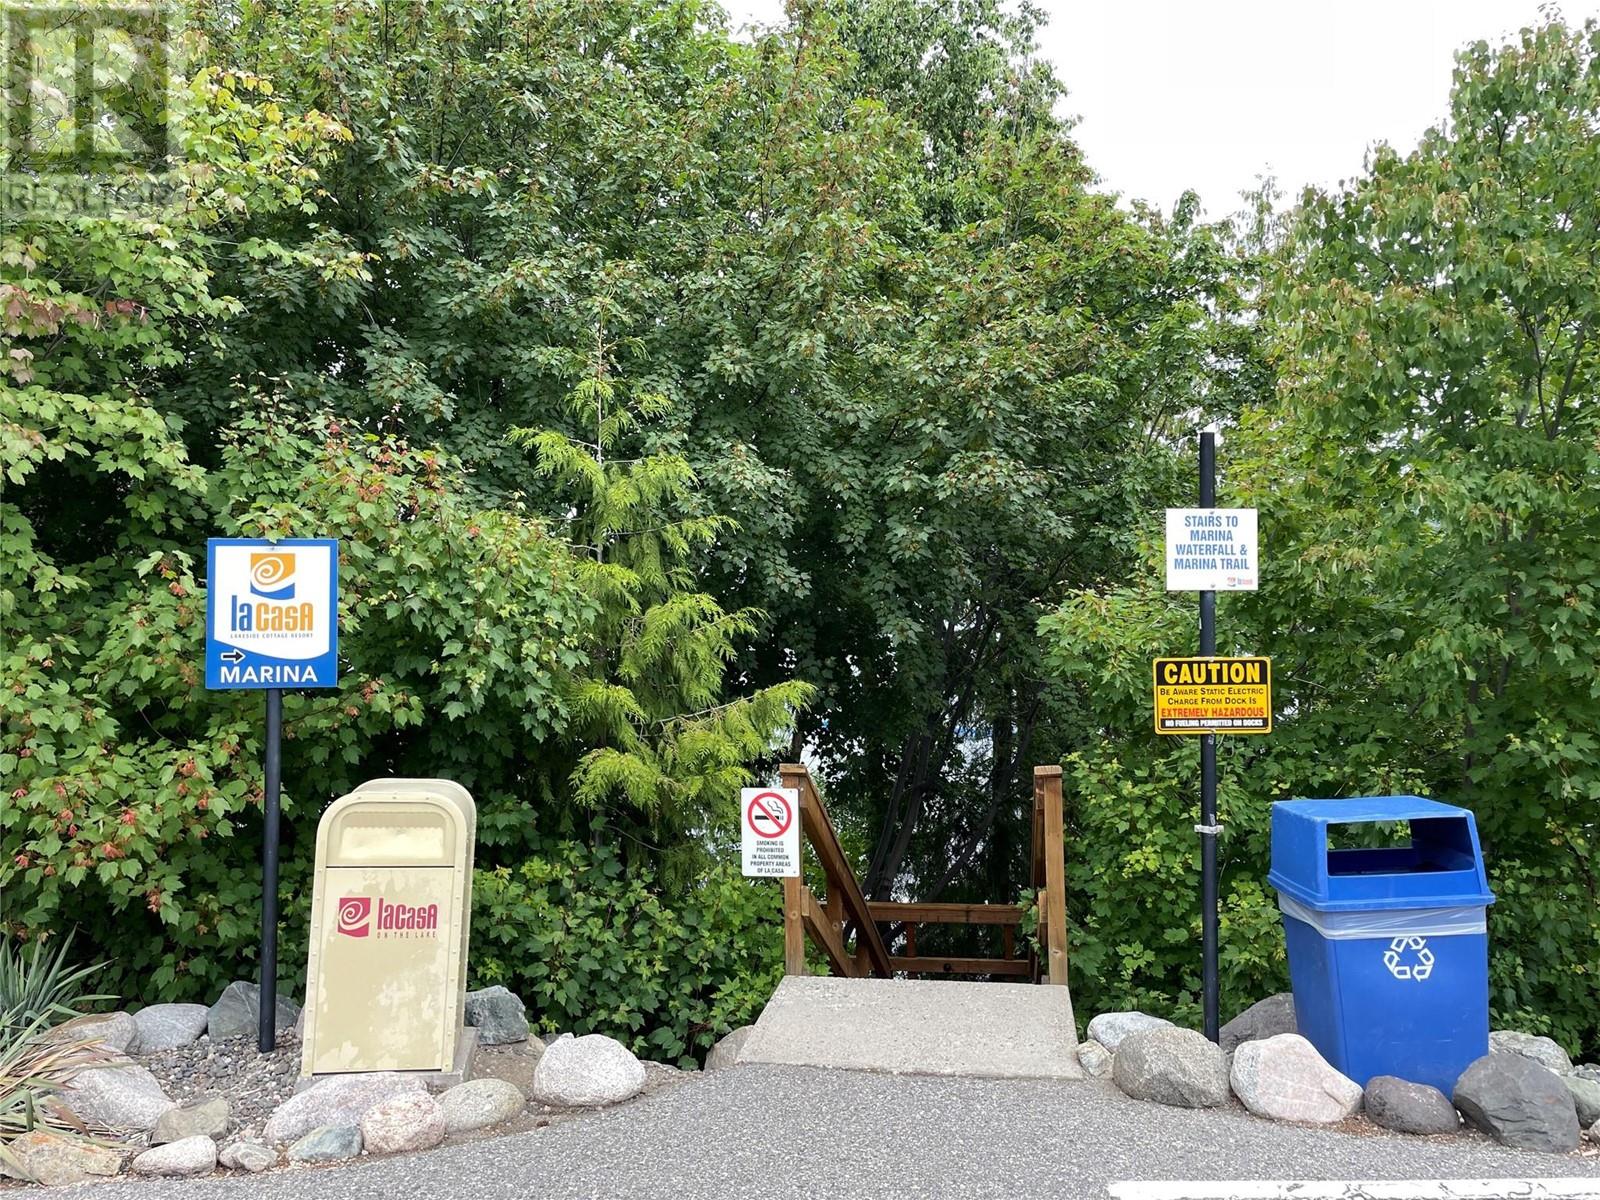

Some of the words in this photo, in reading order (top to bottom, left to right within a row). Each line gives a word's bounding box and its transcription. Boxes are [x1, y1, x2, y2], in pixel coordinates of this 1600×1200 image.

[1184, 515, 1222, 527] STAIRS
[1225, 515, 1238, 527] TO
[1190, 530, 1233, 541] MARINA
[1175, 543, 1236, 555] WATERFALL
[1239, 543, 1248, 555] &
[1174, 558, 1217, 570] MARINA
[1219, 558, 1250, 570] TRAIL
[220, 665, 319, 684] MARINA
[1164, 662, 1260, 684] CAUTION
[1161, 708, 1209, 717] EXTREMELY
[1212, 707, 1264, 717] HAZARDOUS
[1165, 719, 1174, 727] NO
[1200, 719, 1232, 727] PERMITTED
[1233, 719, 1242, 727] ON
[1243, 719, 1263, 727] DOCKS
[394, 931, 409, 939] THE
